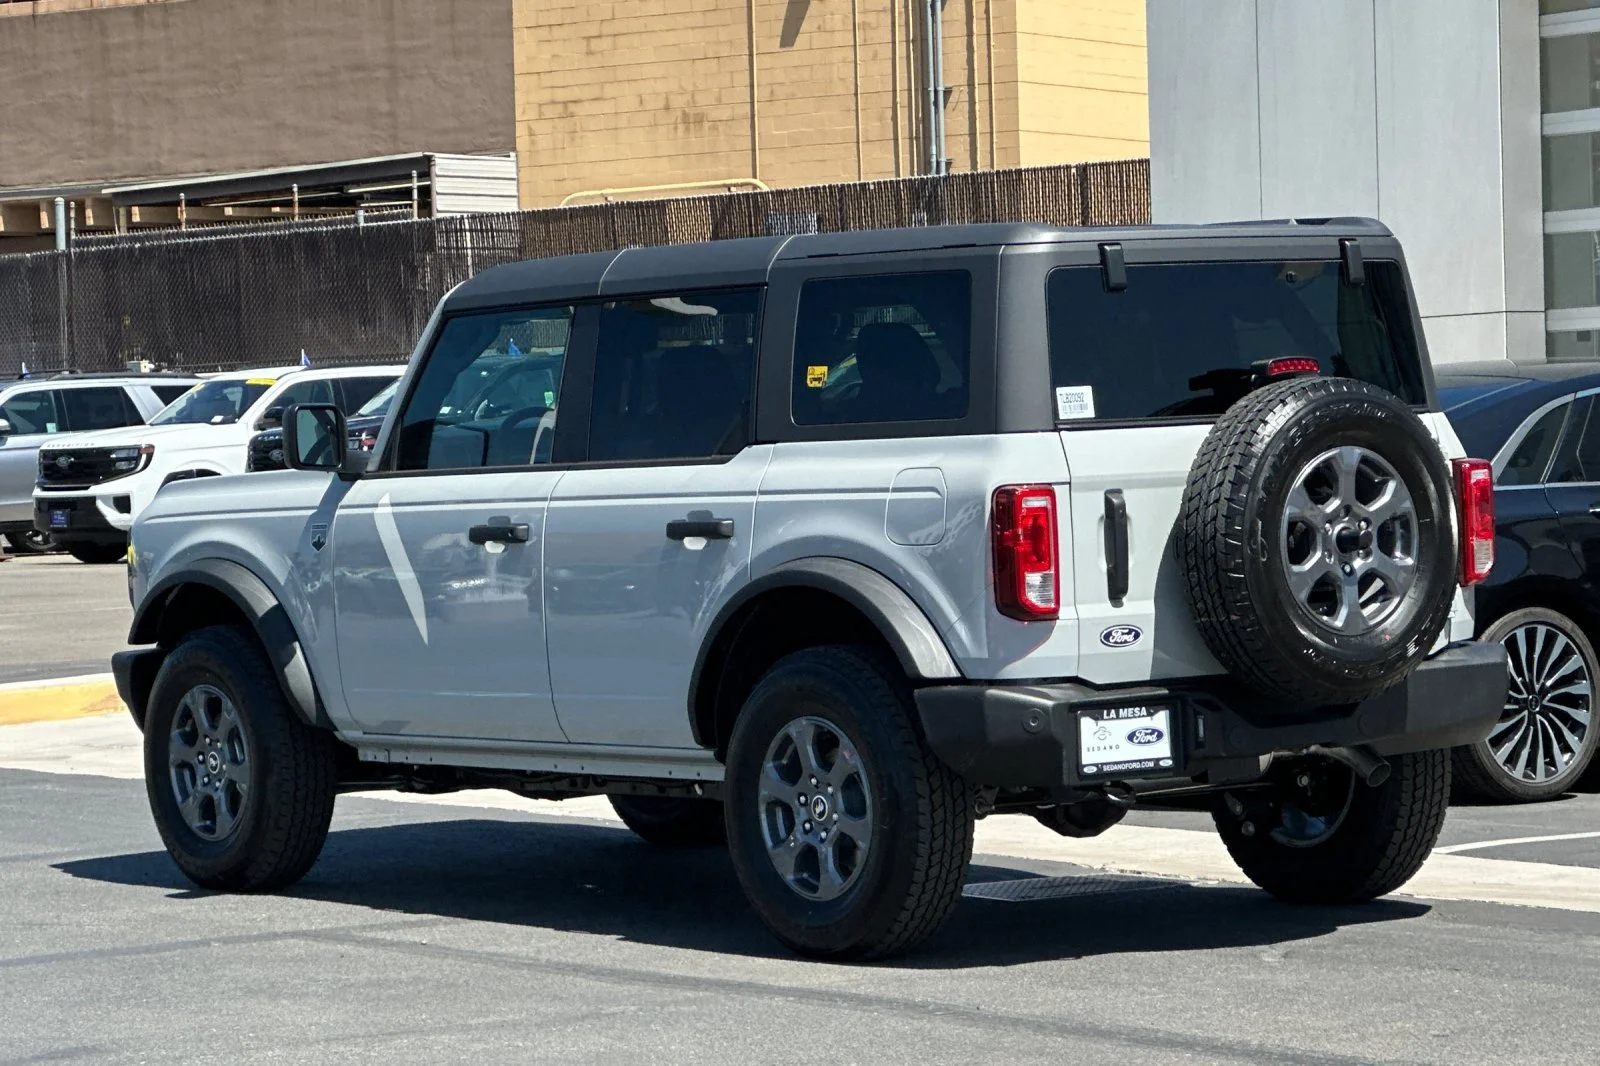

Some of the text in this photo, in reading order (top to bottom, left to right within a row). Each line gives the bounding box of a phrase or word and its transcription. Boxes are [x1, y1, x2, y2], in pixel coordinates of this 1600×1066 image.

[1108, 628, 1136, 644] Ford
[1103, 706, 1148, 720] LA MESA
[1132, 728, 1158, 744] Ford
[1102, 760, 1155, 772] SEDANOFORD.COM
